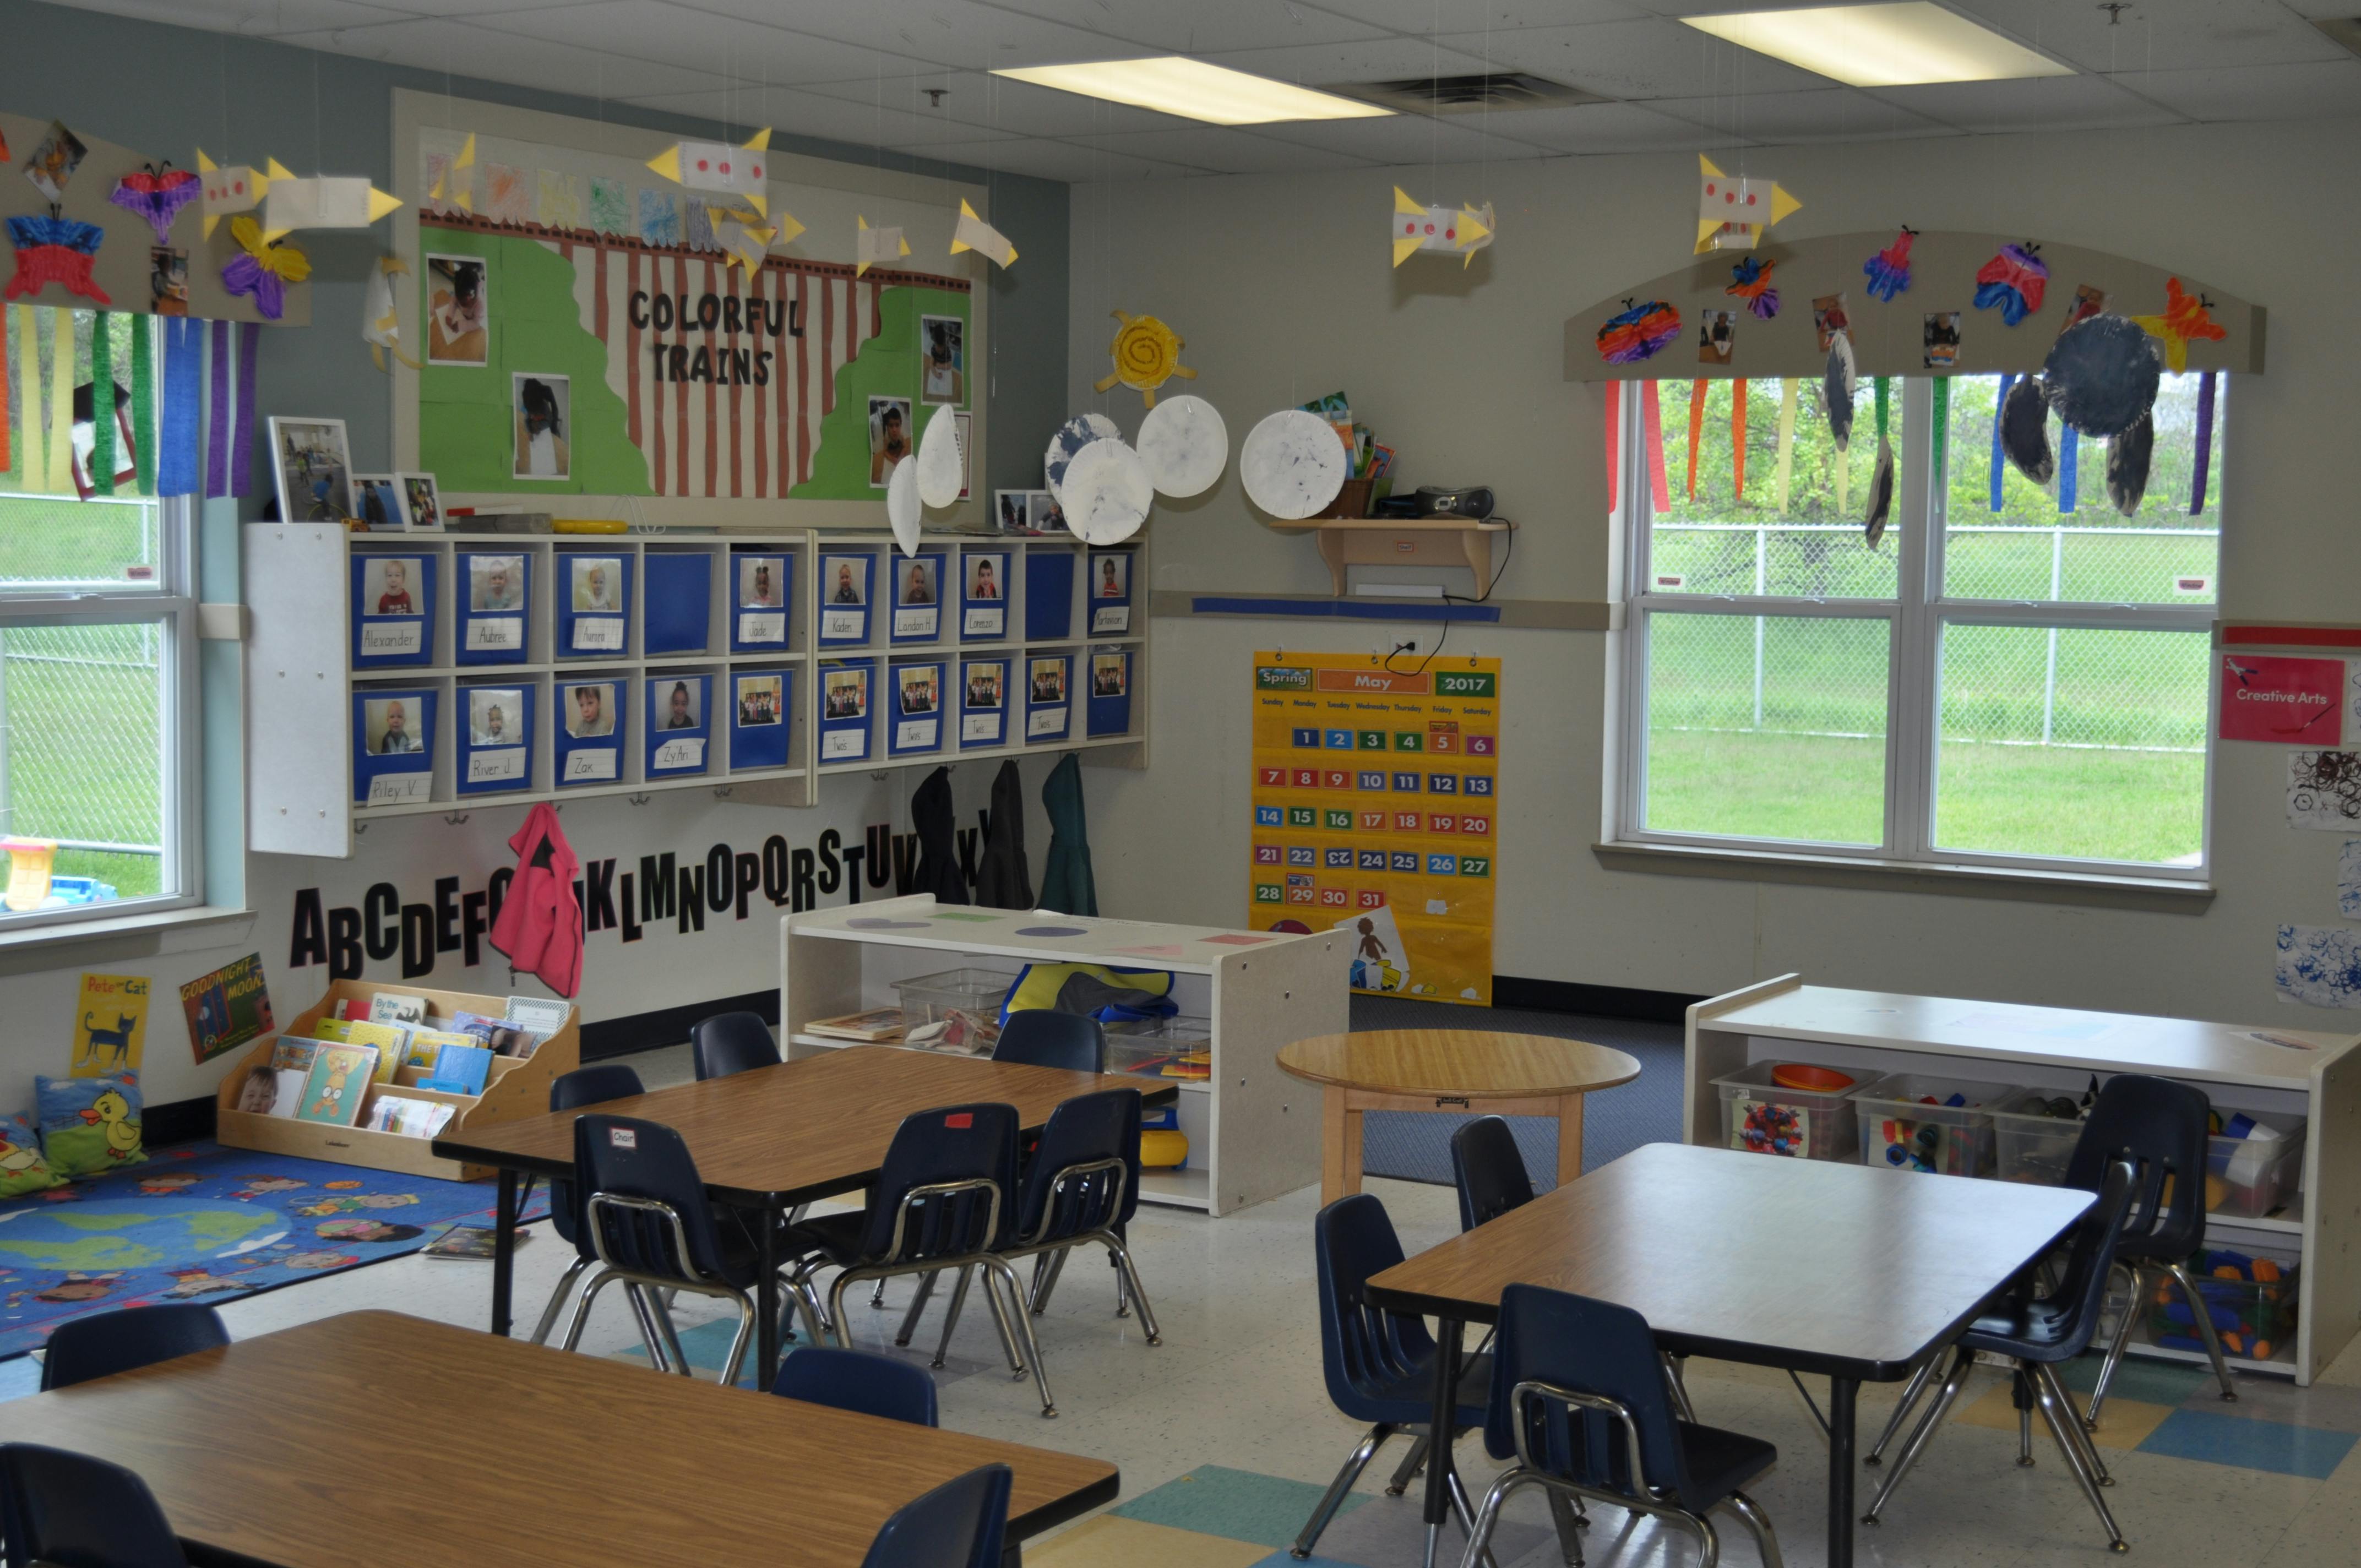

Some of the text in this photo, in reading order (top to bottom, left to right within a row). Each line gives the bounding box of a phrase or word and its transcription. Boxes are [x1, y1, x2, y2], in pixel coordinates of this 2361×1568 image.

[630, 291, 803, 337] COLORFUL
[654, 343, 773, 386] TRAINS
[749, 622, 766, 637] Jade
[833, 618, 851, 632] Kaden
[925, 616, 931, 630] H
[970, 614, 993, 629] Lorenzo
[364, 629, 414, 647] Alexander
[479, 627, 507, 643] Aubree
[583, 627, 605, 642] Aurora
[1263, 672, 1307, 686] Spring
[1354, 675, 1392, 690] May
[1445, 677, 1487, 690] 2017
[2236, 688, 2327, 705] Creative Arts
[1262, 698, 1491, 716] Sunday Monday Tuesday Wednesday Thursday Friday Saturday
[1303, 732, 1486, 752] 1 2 3 4 5 6
[474, 757, 511, 776] River J
[1268, 771, 1488, 792] 7 8 9 10 11 12 13
[373, 779, 417, 803] Riley V
[1261, 810, 1486, 832] 14 15 16 17 18 19 20
[1260, 848, 1276, 861] 21
[1291, 850, 1312, 863] 22
[1362, 854, 1383, 867] 24
[1394, 855, 1415, 869] 25
[1431, 858, 1452, 871] 26
[1464, 860, 1486, 873] 27
[1259, 887, 1379, 906] 28 29 30 31
[88, 976, 115, 993] Pete
[125, 979, 148, 995] Cat
[182, 957, 252, 1001] GOODNIGHT
[228, 972, 262, 1000] MOON
[376, 998, 399, 1009] By the
[378, 1010, 392, 1020] Sea
[416, 1043, 432, 1053] THE
[614, 1132, 633, 1142] Chair
